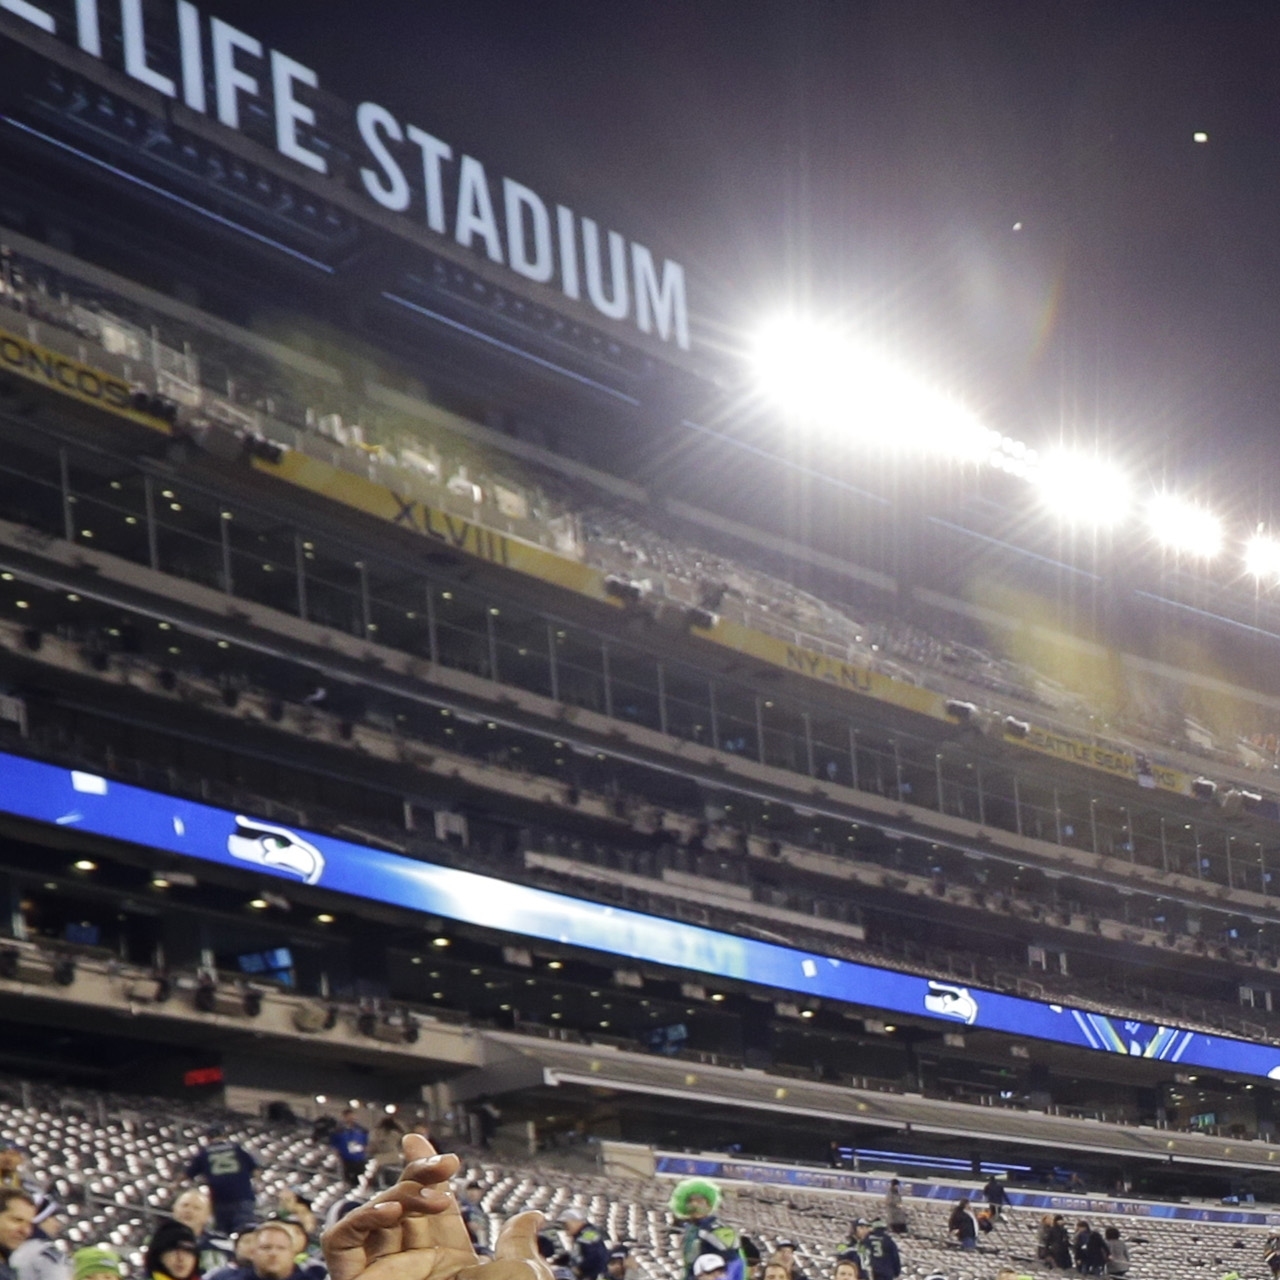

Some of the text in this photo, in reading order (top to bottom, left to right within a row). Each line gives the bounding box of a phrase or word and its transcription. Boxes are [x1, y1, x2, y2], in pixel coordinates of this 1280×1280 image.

[0, 0, 691, 350] LIFE STADIUM
[391, 491, 509, 565] XLVIII
